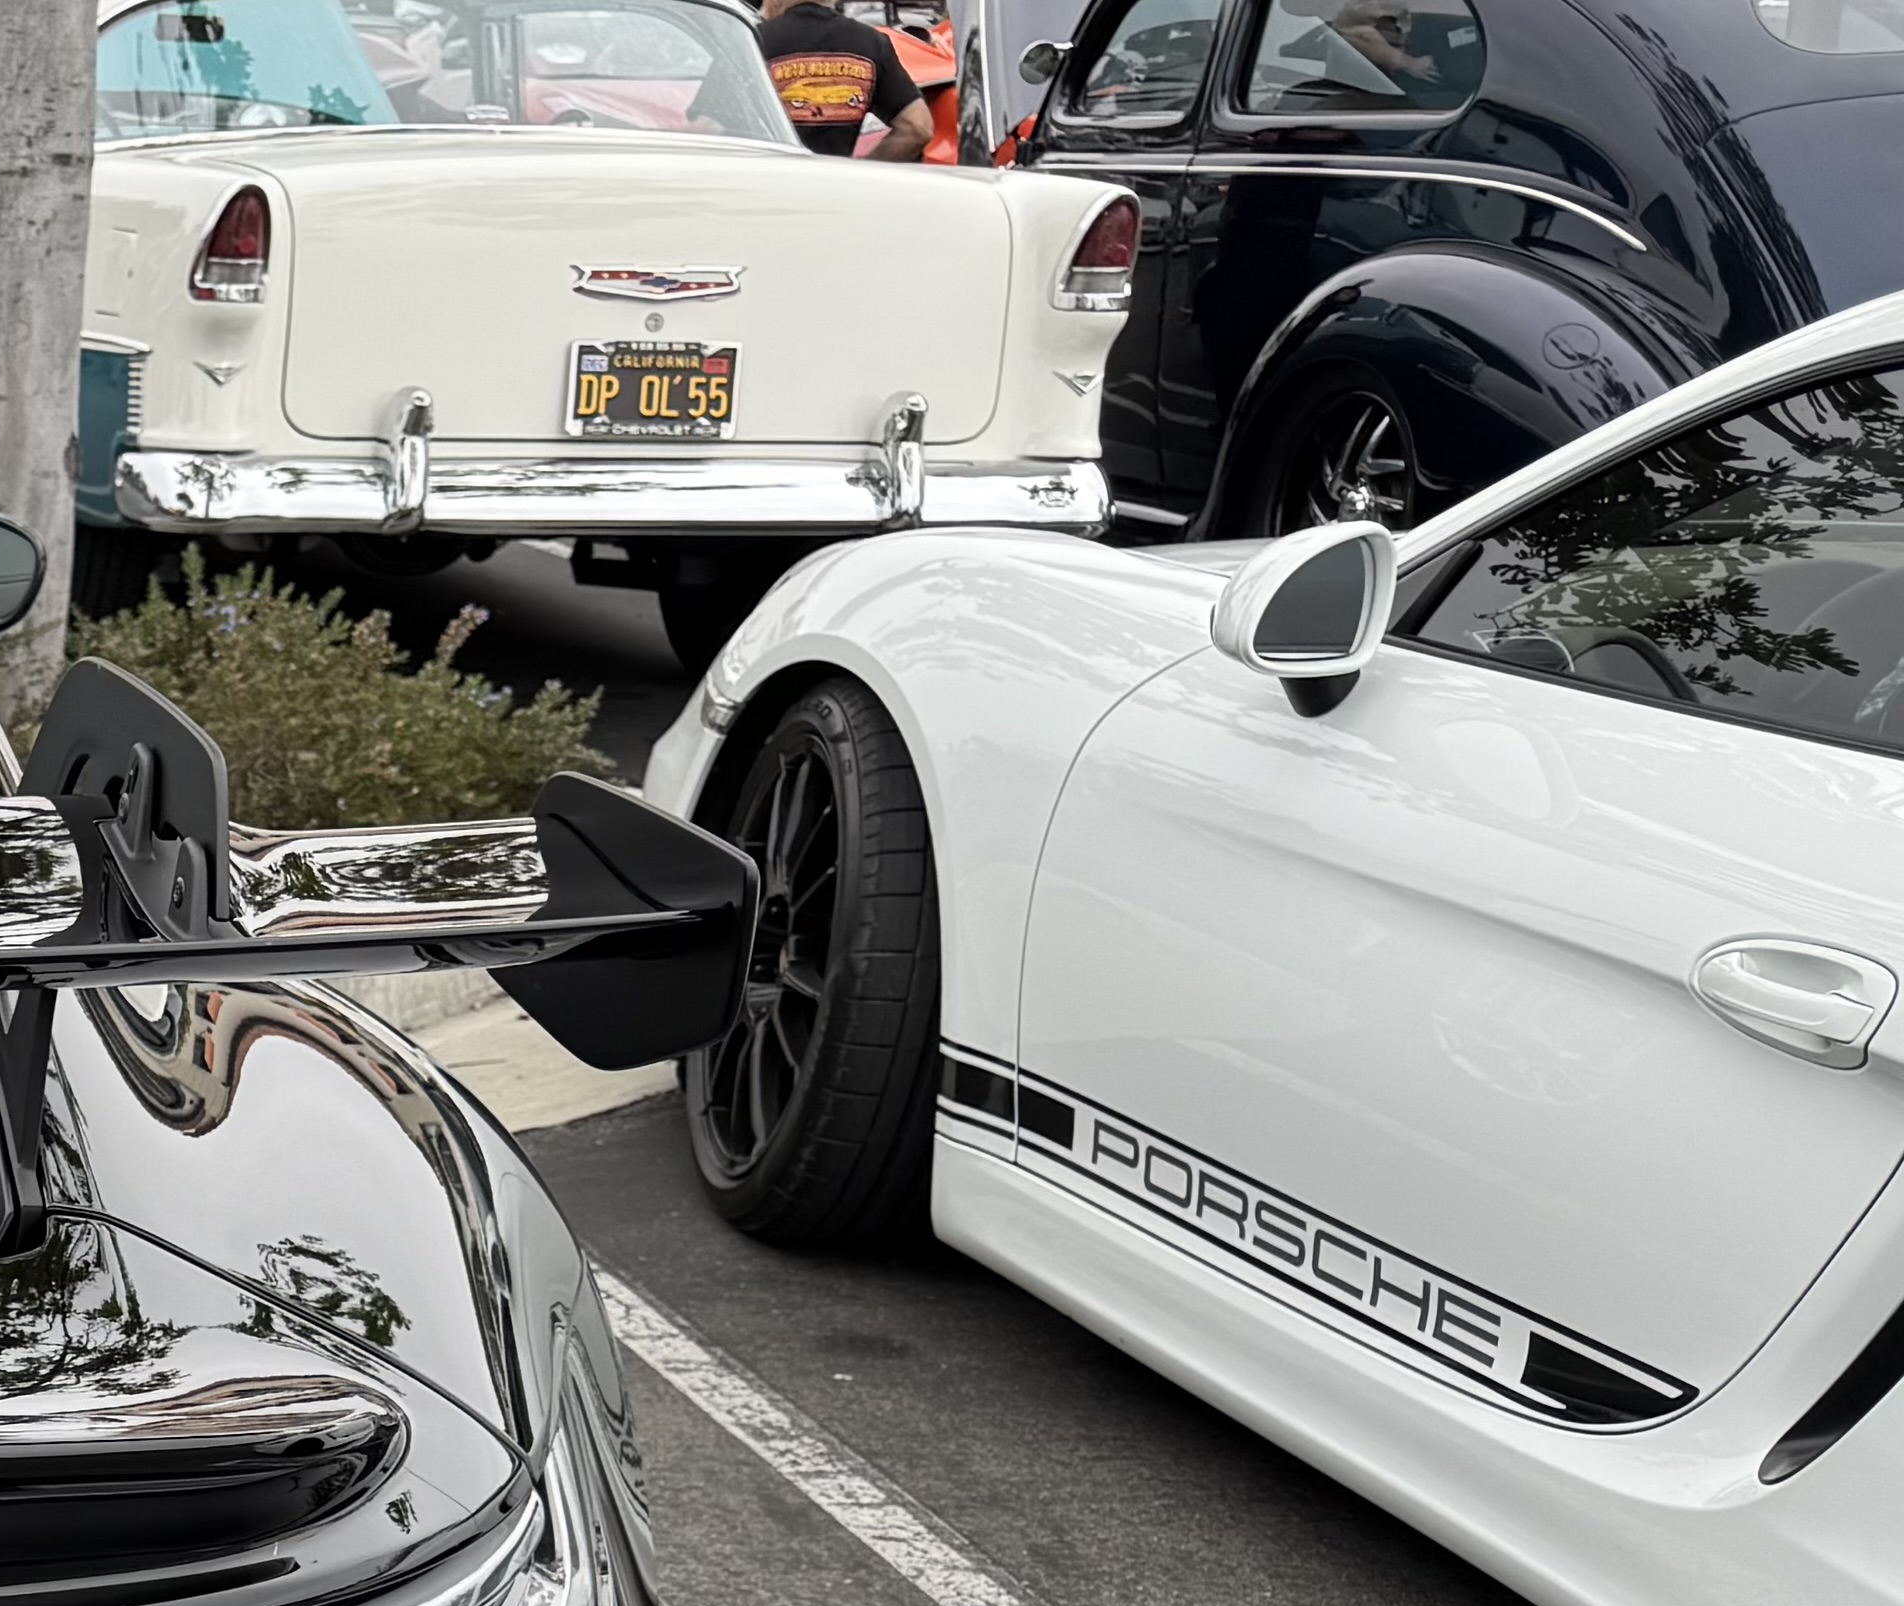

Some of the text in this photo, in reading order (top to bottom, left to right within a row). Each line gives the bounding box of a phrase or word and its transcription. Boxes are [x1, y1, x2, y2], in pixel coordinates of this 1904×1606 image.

[613, 354, 700, 369] CALIFORNIA
[577, 374, 620, 416] DP
[1092, 1118, 1501, 1369] PORSCHE
